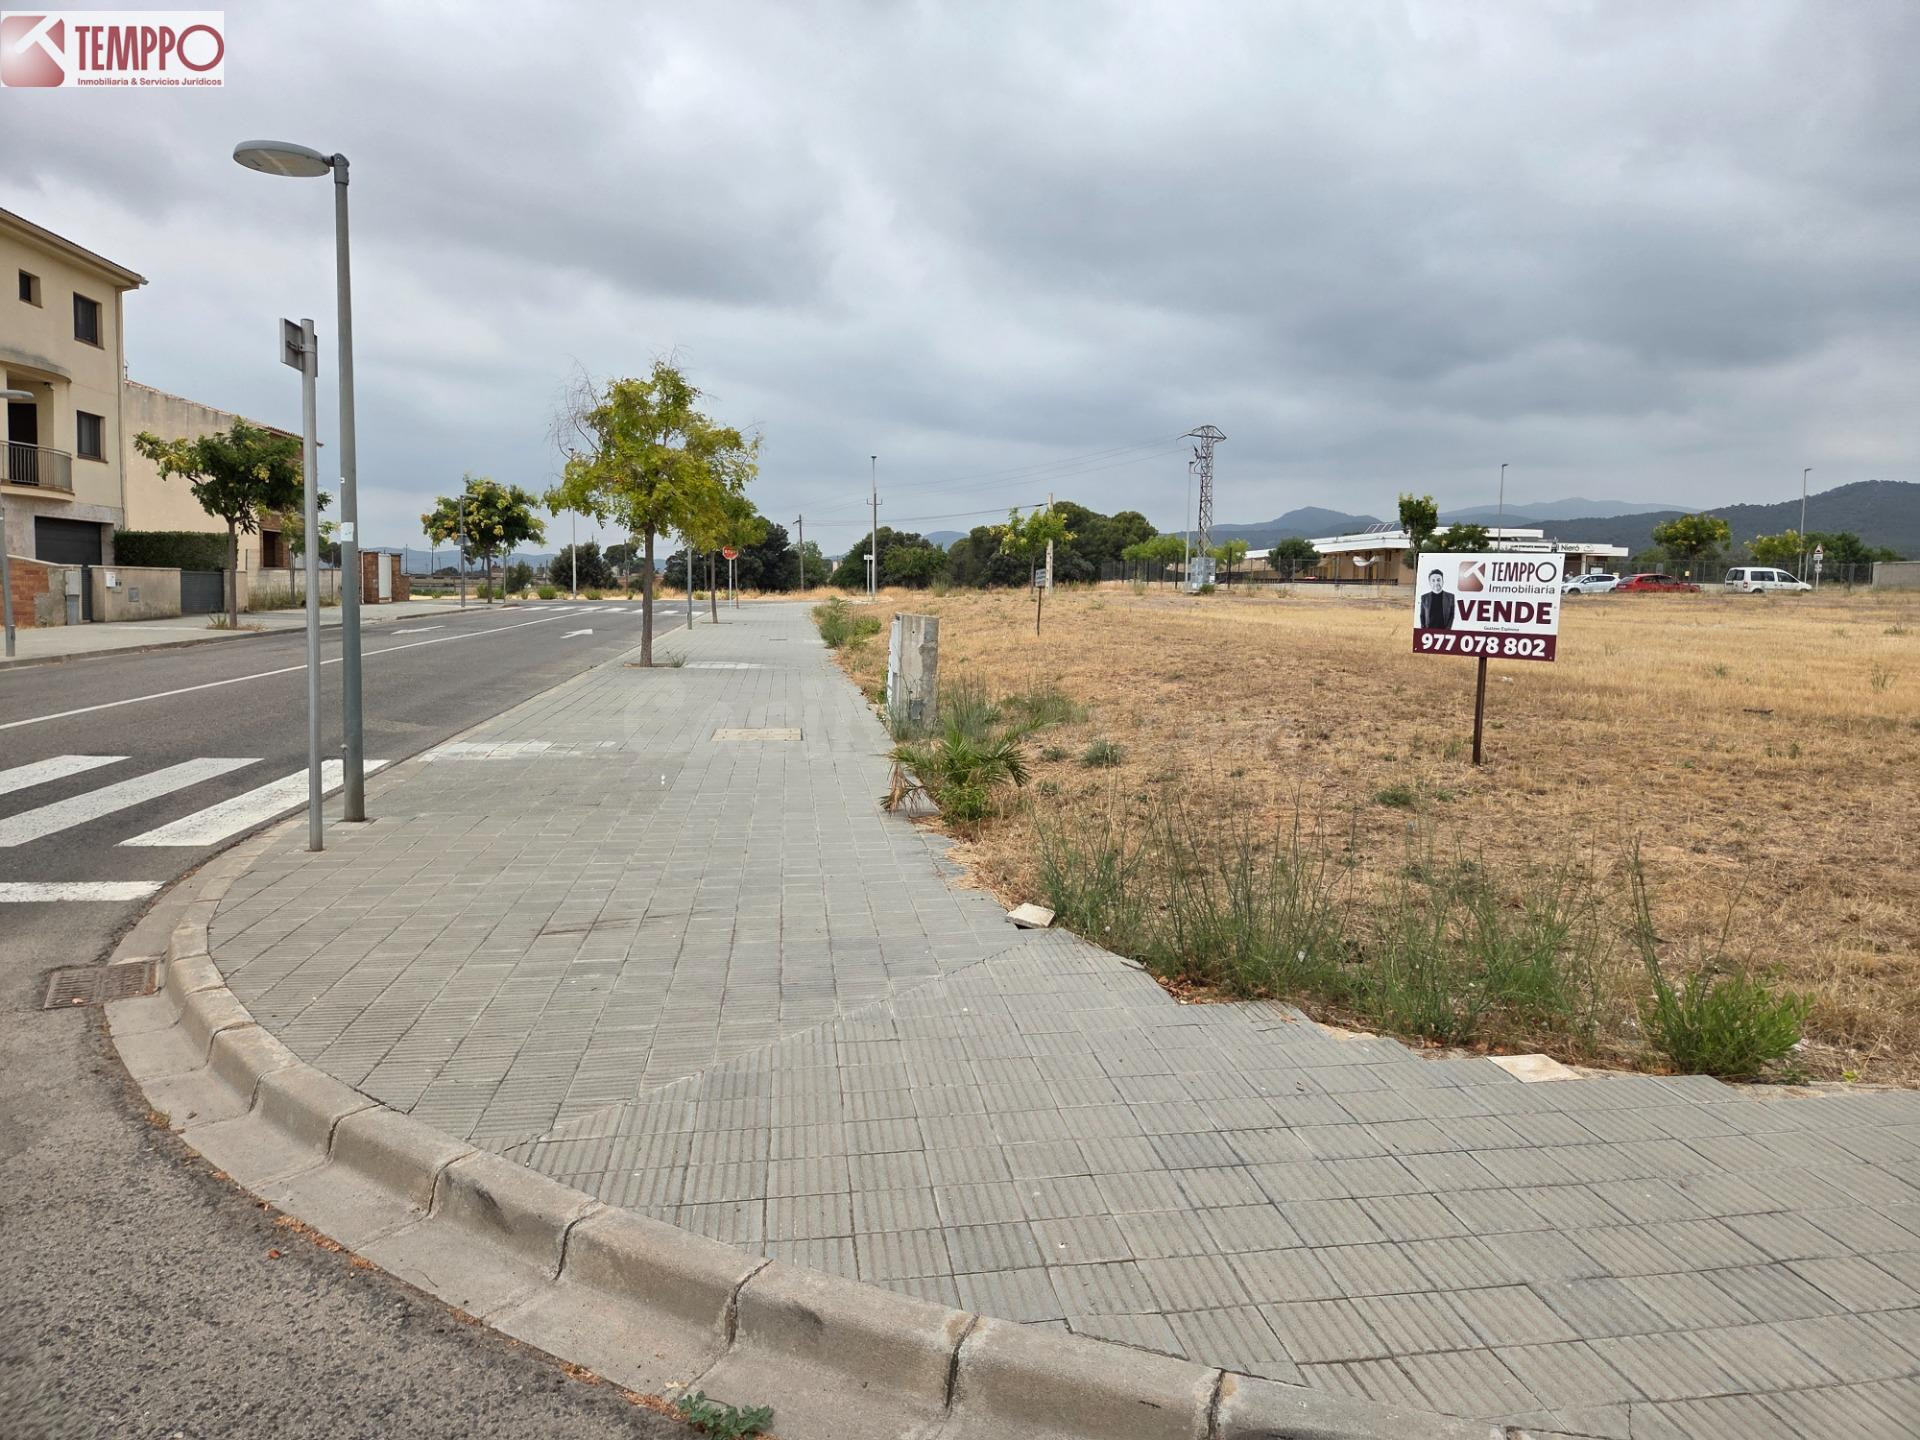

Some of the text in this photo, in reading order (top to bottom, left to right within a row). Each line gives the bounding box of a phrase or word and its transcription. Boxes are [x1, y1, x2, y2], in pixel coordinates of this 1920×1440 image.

[1491, 561, 1557, 583] TEMPPO
[1457, 599, 1552, 625] VENDE
[1421, 633, 1546, 657] 977 078 802
